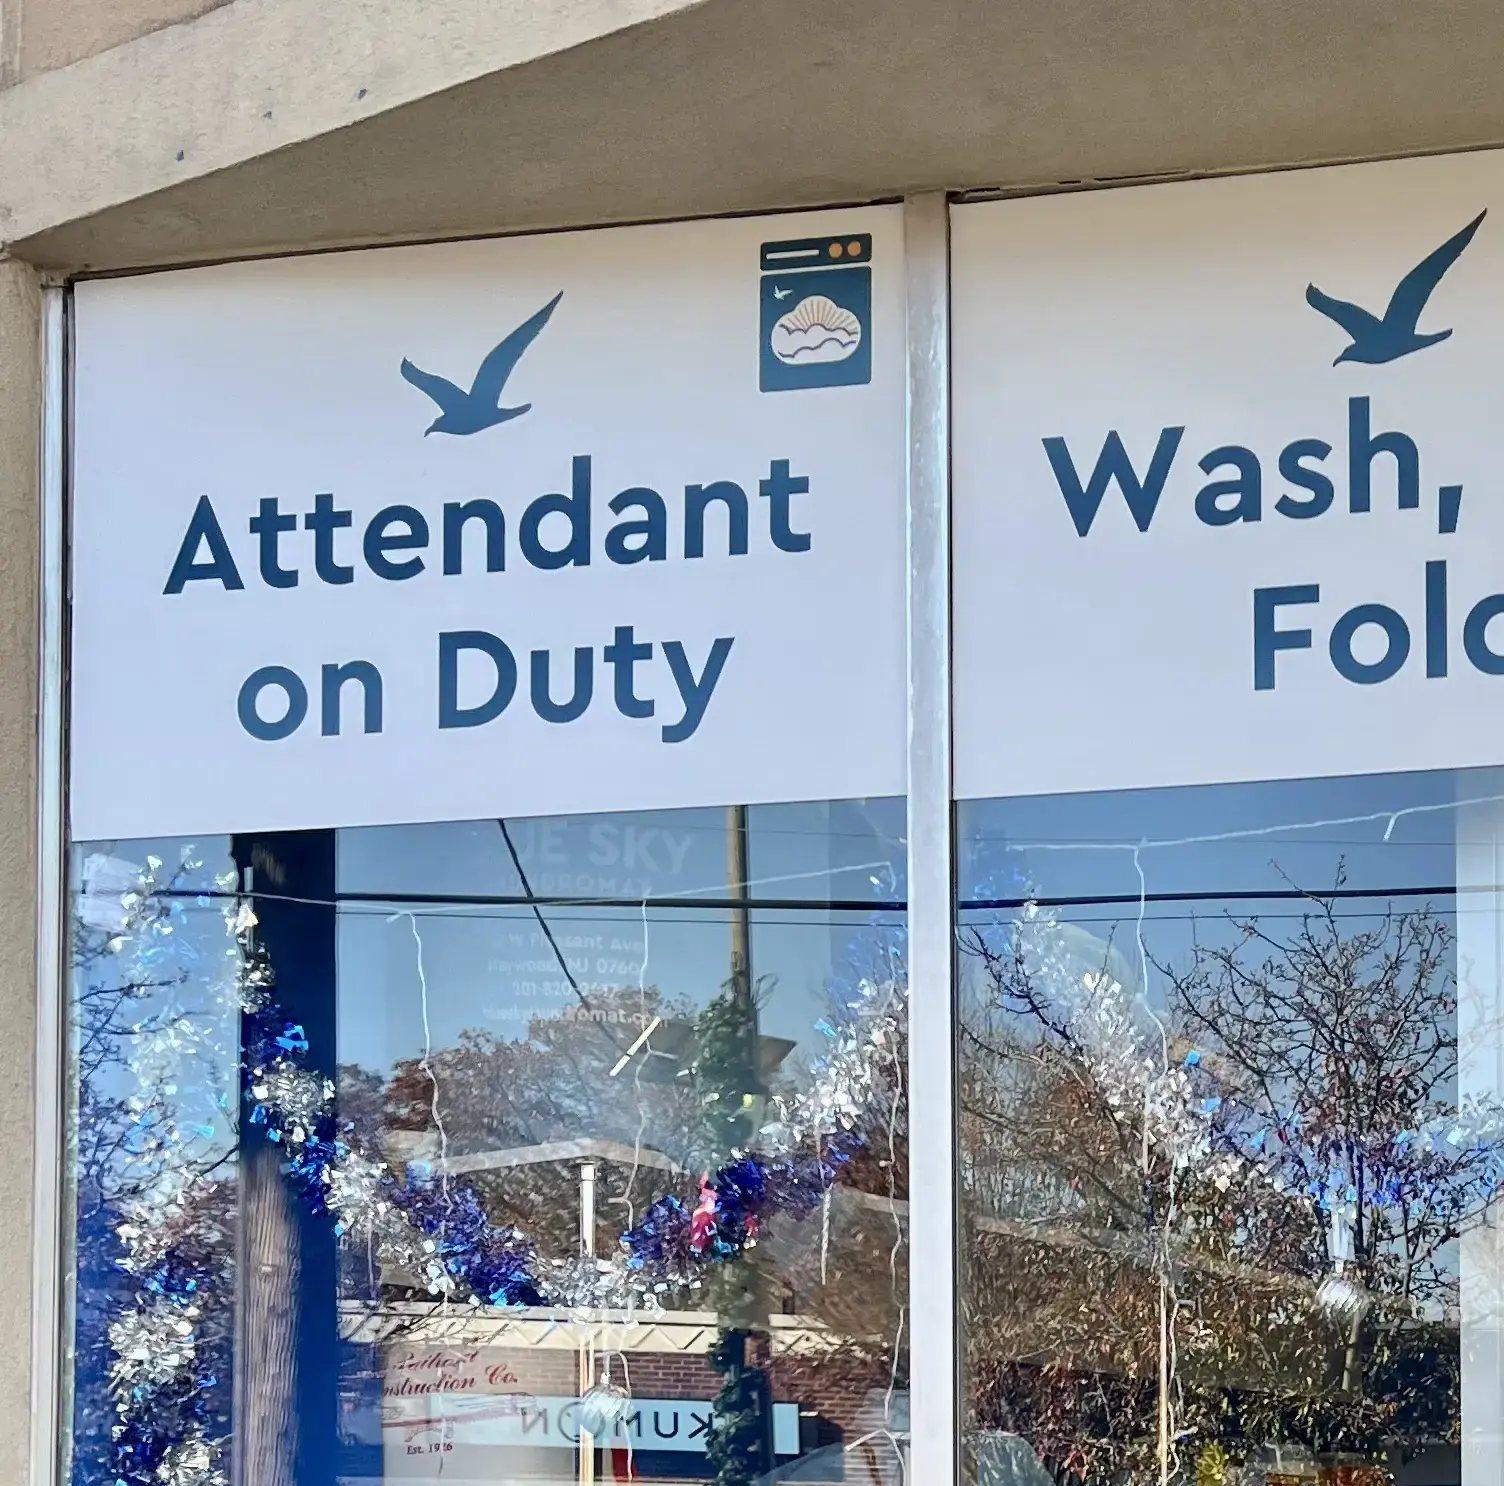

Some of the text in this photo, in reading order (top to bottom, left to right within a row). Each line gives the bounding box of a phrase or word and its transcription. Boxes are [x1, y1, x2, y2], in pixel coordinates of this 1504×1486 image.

[163, 454, 812, 594] Attendant
[1041, 396, 1463, 537] Wash,
[236, 626, 735, 744] on Duty
[484, 1363, 519, 1386] Co.
